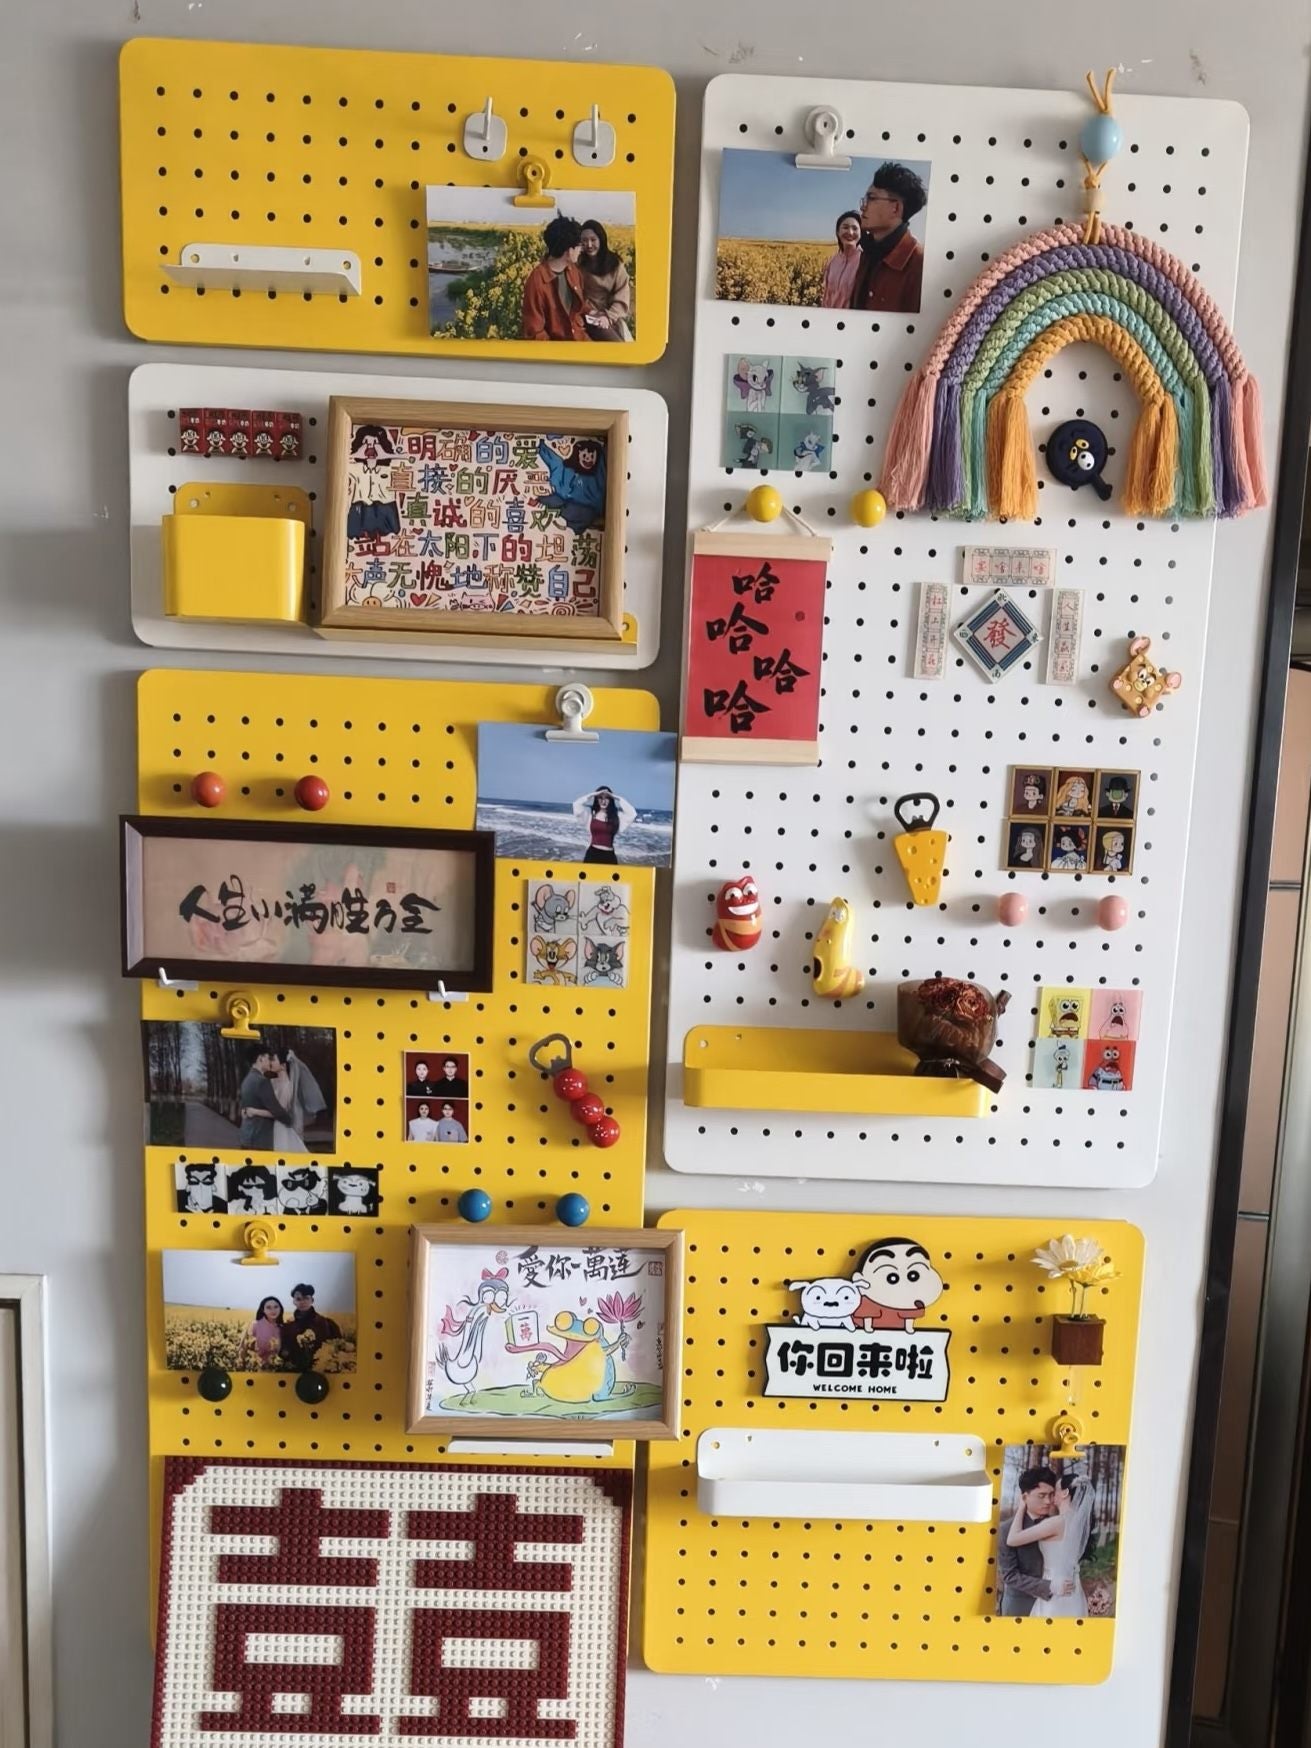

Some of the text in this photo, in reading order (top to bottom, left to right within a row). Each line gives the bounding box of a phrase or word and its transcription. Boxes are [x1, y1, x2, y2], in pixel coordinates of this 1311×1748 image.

[387, 462, 553, 497] 直接的厌恶
[402, 492, 567, 532] 真诚的喜欢
[354, 528, 599, 567] 站在太阳下的坦荡
[345, 557, 597, 599] 大声无愧地称赞自己
[731, 562, 781, 604] 哈
[705, 602, 769, 654] 哈
[753, 648, 811, 695] 哈
[703, 680, 772, 734] 哈
[777, 1340, 934, 1379] 你回来啦
[813, 1383, 897, 1394] WELCOME HOME
